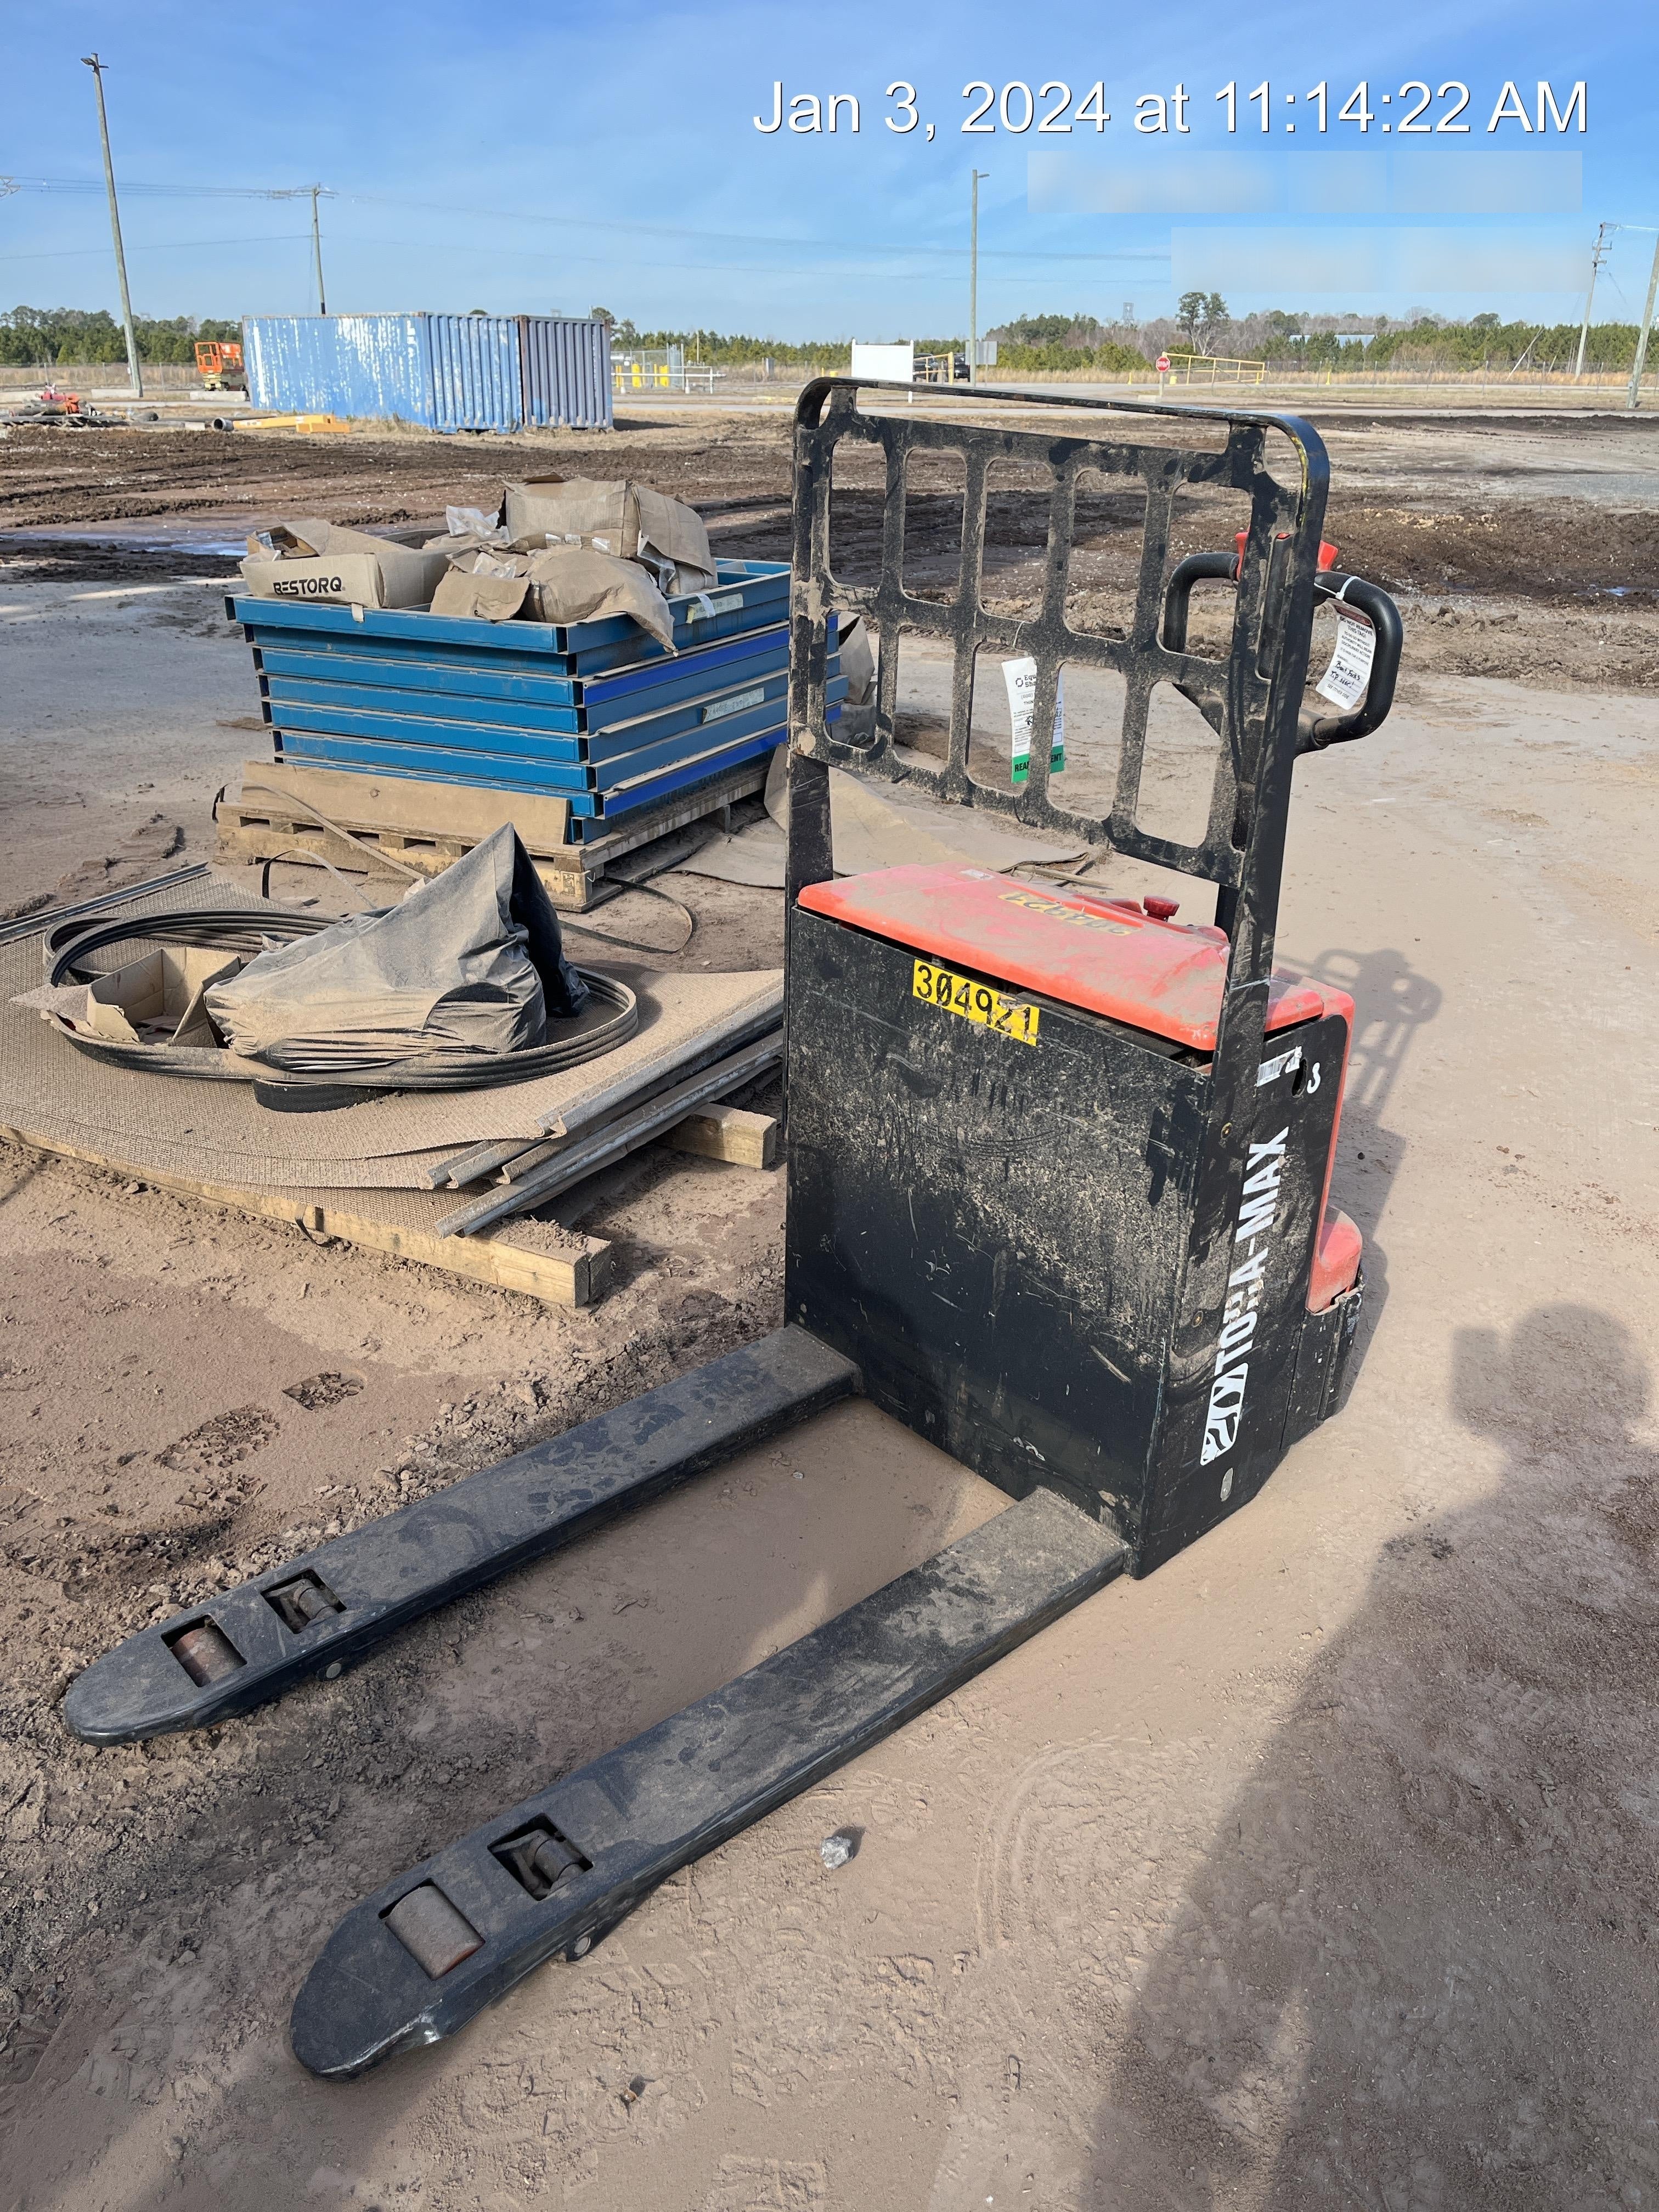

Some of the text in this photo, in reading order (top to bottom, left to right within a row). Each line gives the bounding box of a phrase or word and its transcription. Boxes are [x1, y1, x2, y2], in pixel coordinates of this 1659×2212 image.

[273, 576, 342, 595] BESTORQ
[1050, 752, 1063, 764] ENT
[916, 964, 1031, 1042] 304921
